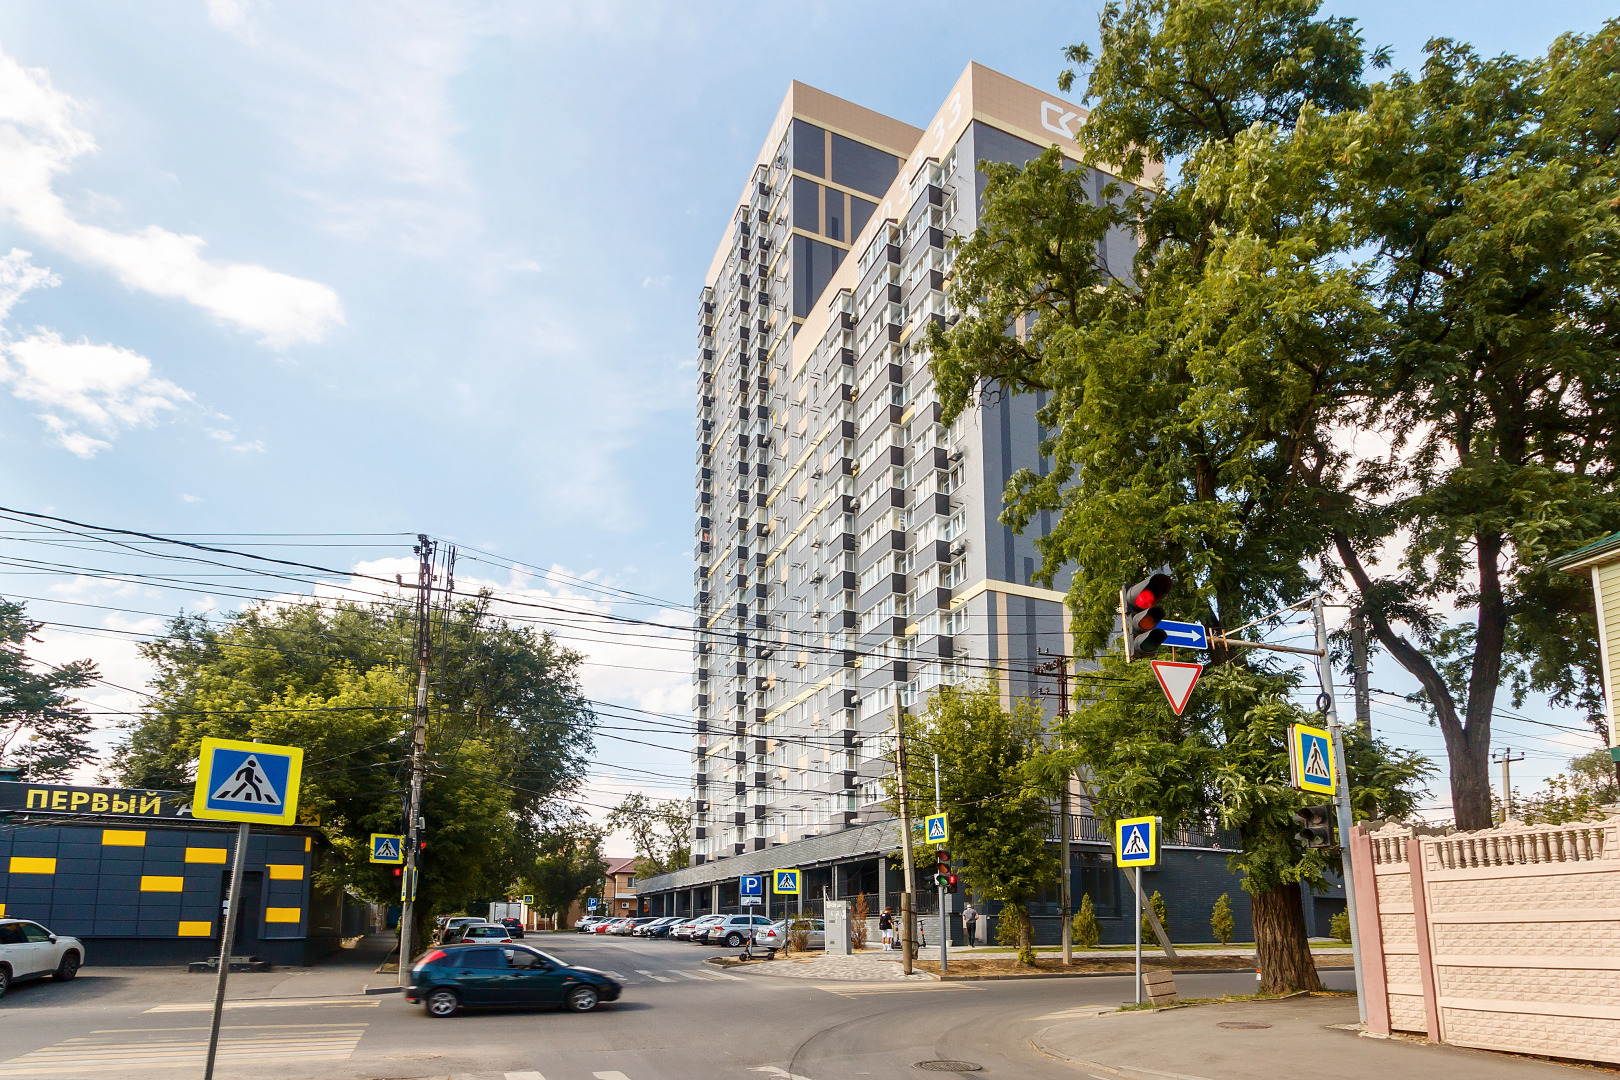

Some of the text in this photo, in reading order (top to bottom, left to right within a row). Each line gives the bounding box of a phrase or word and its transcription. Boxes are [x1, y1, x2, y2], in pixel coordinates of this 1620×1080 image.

[932, 91, 962, 153] 33
[26, 788, 162, 815] ПЕРВЫЙ
[746, 878, 758, 893] P
